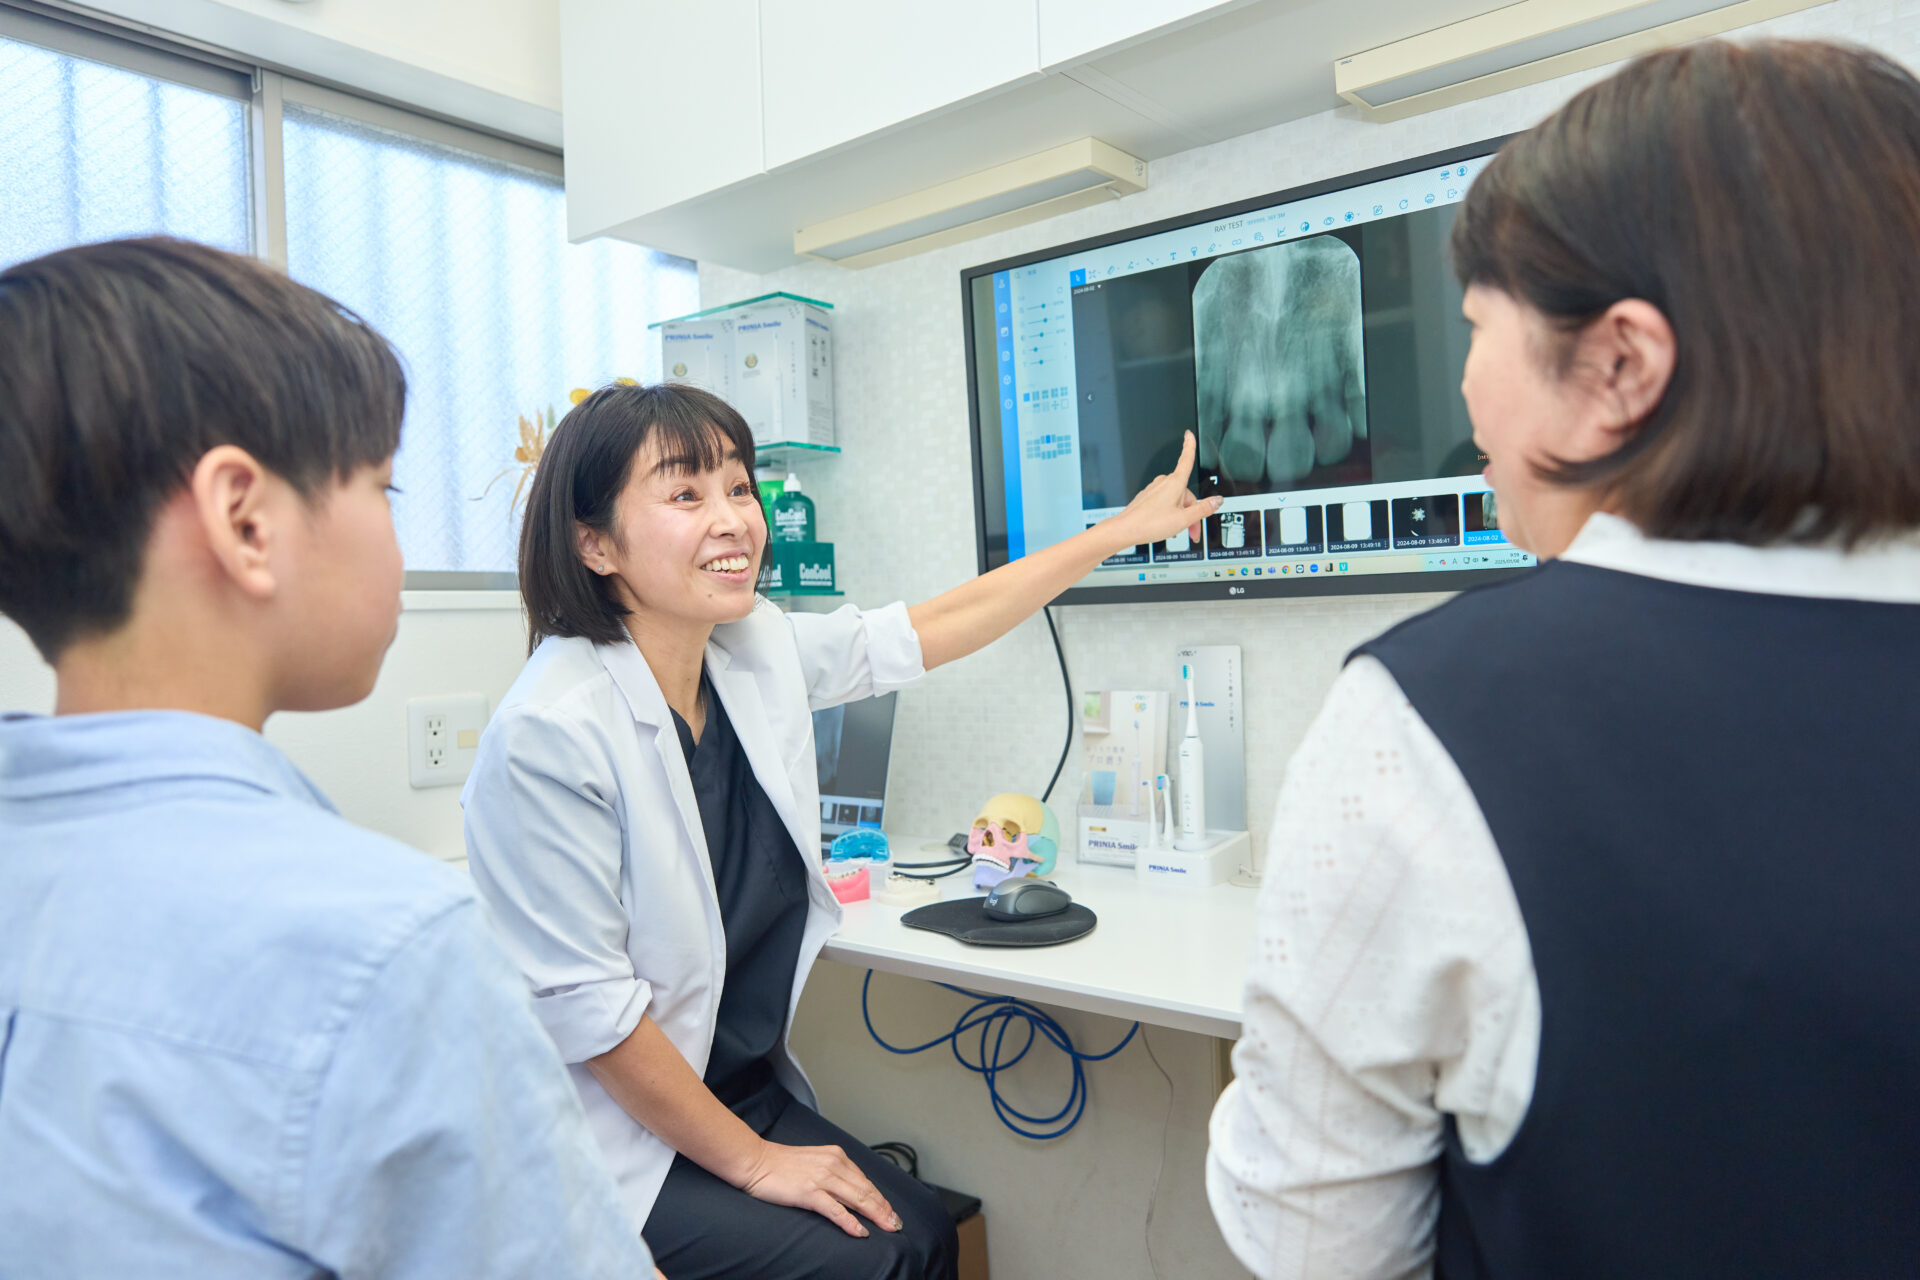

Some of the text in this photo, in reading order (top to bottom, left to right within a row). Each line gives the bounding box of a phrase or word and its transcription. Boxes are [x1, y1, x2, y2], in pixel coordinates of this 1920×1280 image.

[1214, 224, 1227, 233] RAY
[1228, 220, 1243, 230] TEST
[1330, 543, 1358, 551] 2024-08-09
[1396, 539, 1426, 547] 2024-08-09
[1088, 839, 1116, 849] PRINIA
[1148, 864, 1187, 874] PRINIA Smile
